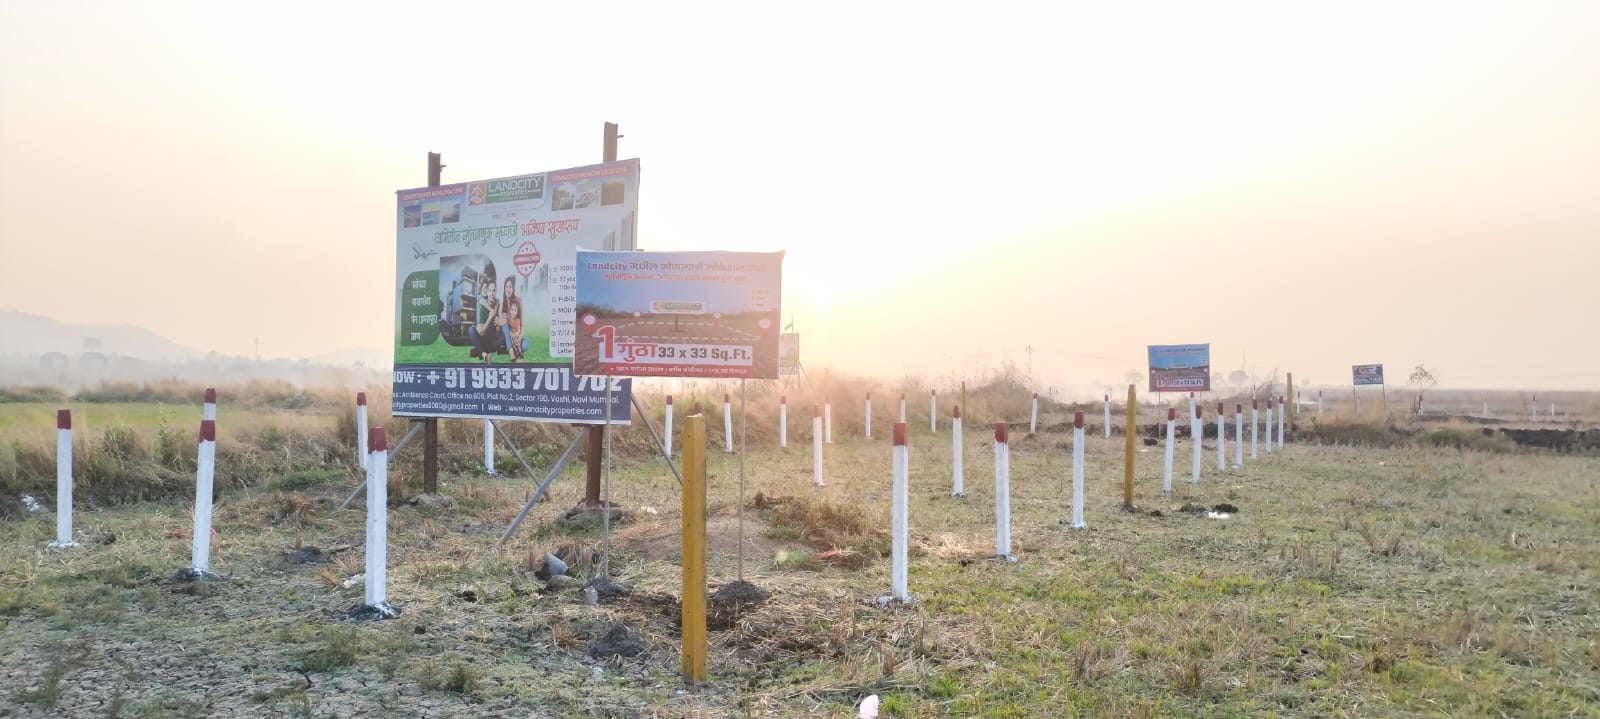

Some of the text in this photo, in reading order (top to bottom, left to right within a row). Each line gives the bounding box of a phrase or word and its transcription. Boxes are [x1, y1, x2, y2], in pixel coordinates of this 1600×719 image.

[488, 176, 541, 193] LANDCITY
[587, 262, 627, 272] Landcity
[566, 276, 576, 284] yea
[597, 326, 751, 362] 1 गुंठा 33 x 33 Sq.Ft.
[444, 367, 466, 389] 91
[471, 367, 525, 390] 9833
[531, 367, 570, 391] 701
[447, 392, 464, 400] Office
[486, 392, 499, 401] Plot
[515, 393, 536, 402] Sector
[572, 396, 588, 404] Navi
[487, 403, 502, 412] Web
